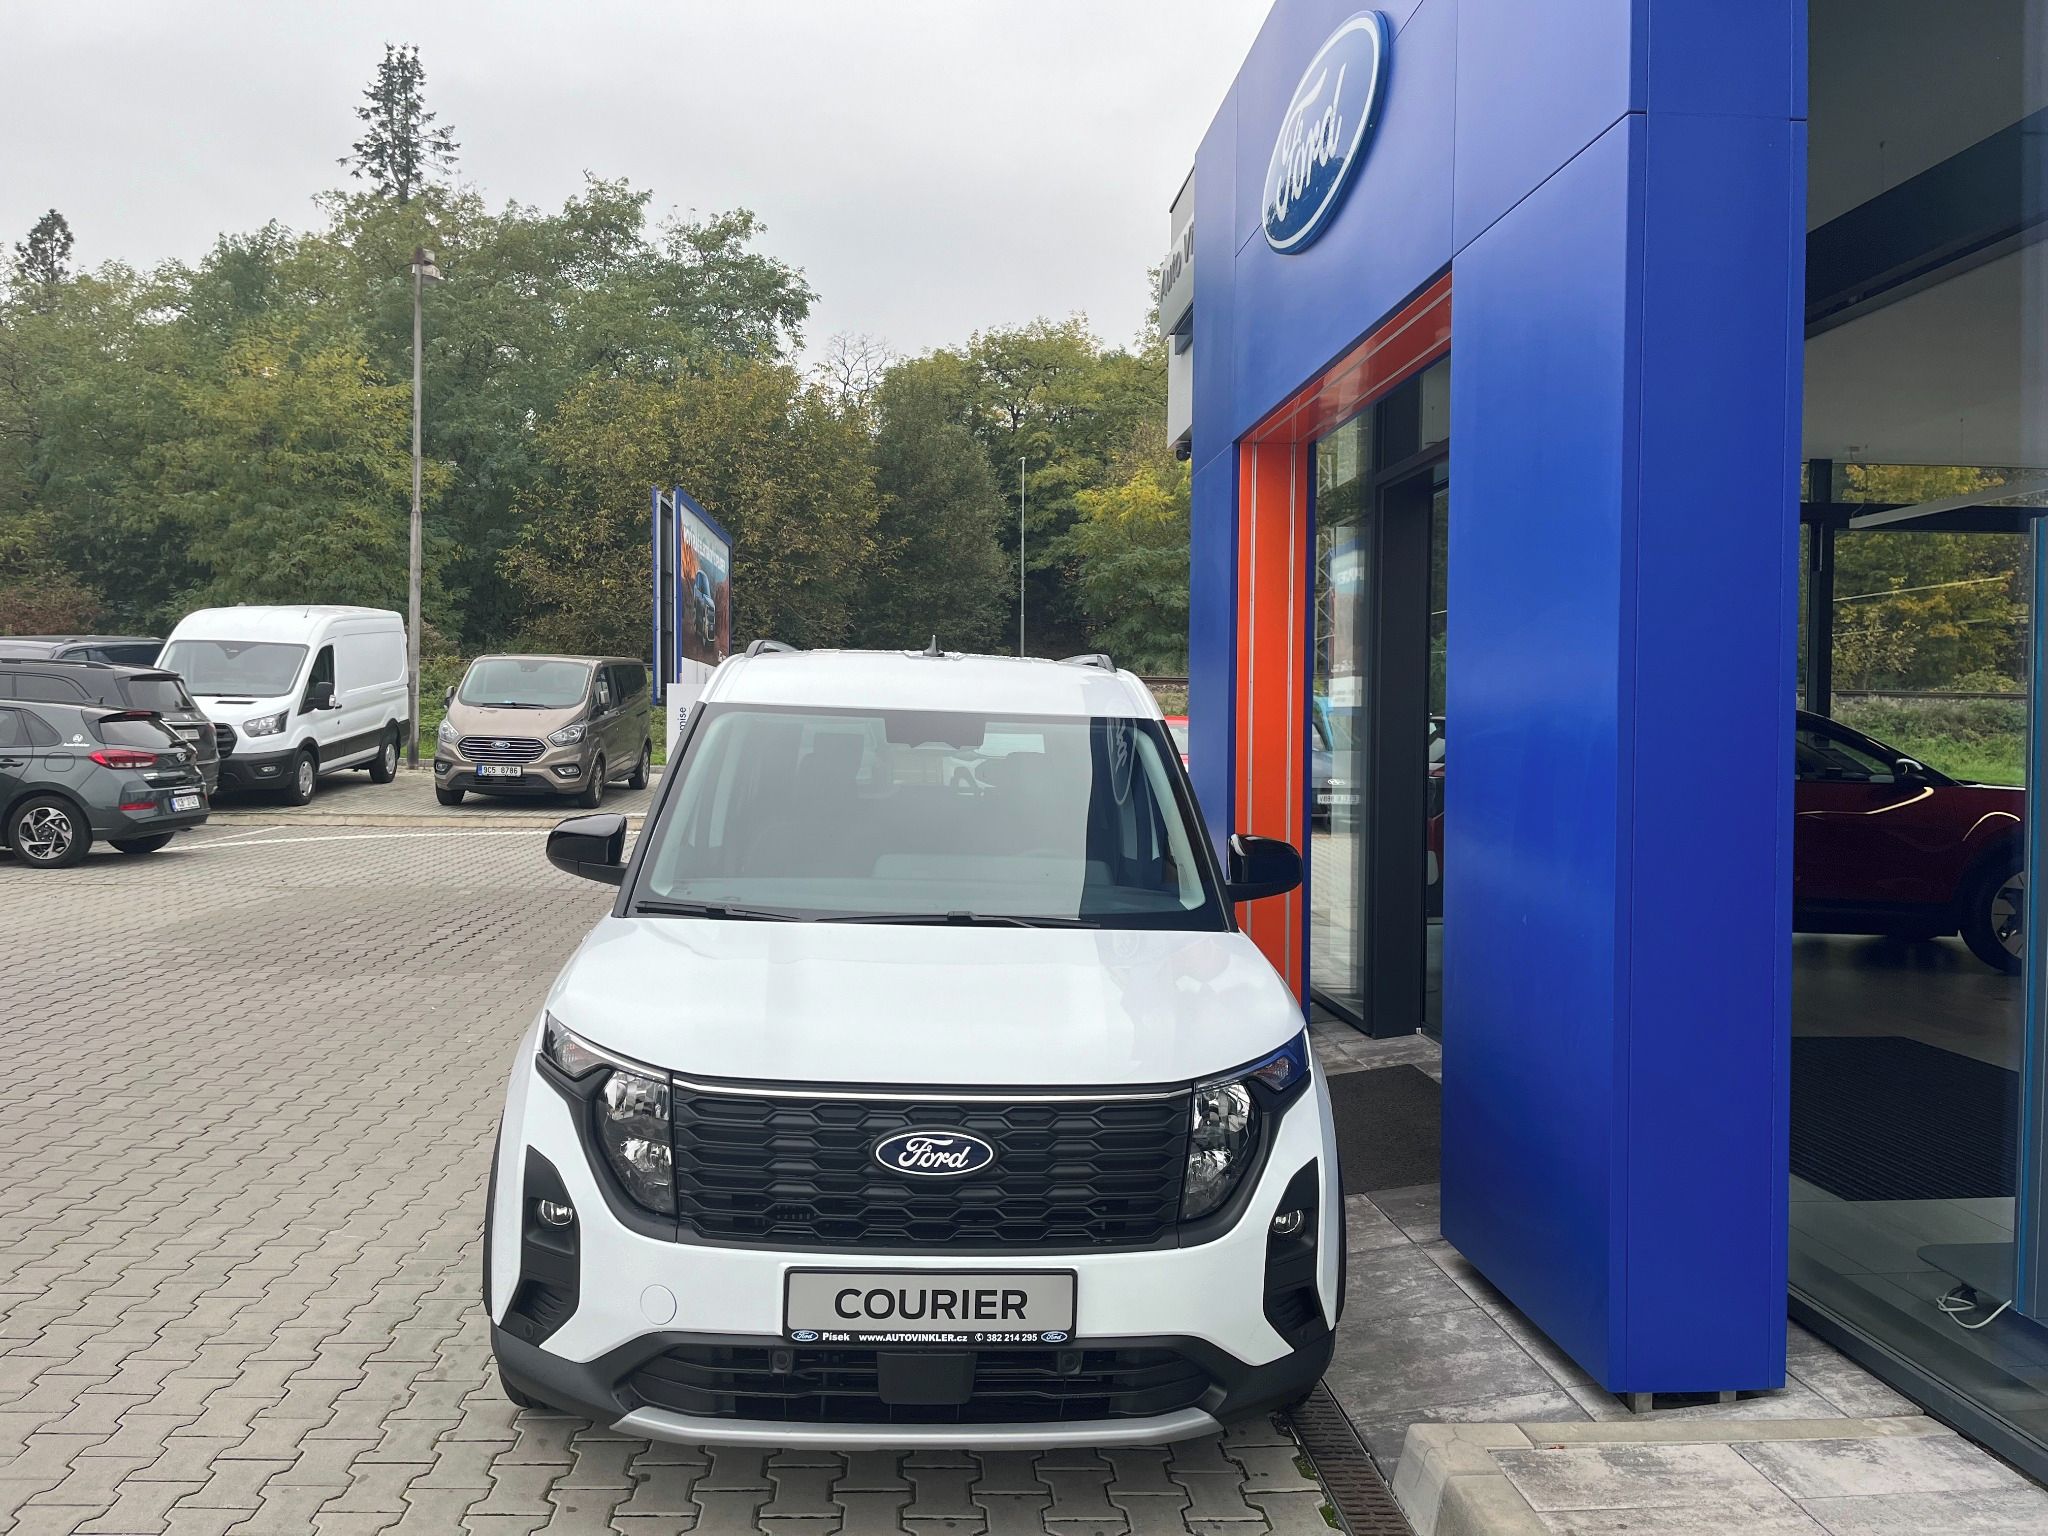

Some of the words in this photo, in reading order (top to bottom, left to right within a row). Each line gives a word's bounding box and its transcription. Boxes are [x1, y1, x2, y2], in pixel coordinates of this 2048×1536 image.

[1276, 62, 1347, 222] Ford
[1160, 250, 1182, 303] Auto
[677, 706, 687, 735] mise
[483, 766, 496, 774] 9C5
[898, 1137, 971, 1168] Ford
[834, 1288, 1028, 1320] COURIER
[858, 1333, 968, 1342] www.AUTOVINKLER.cz
[986, 1333, 1002, 1342] 382
[1004, 1333, 1020, 1342] 214
[1021, 1333, 1038, 1342] 295
